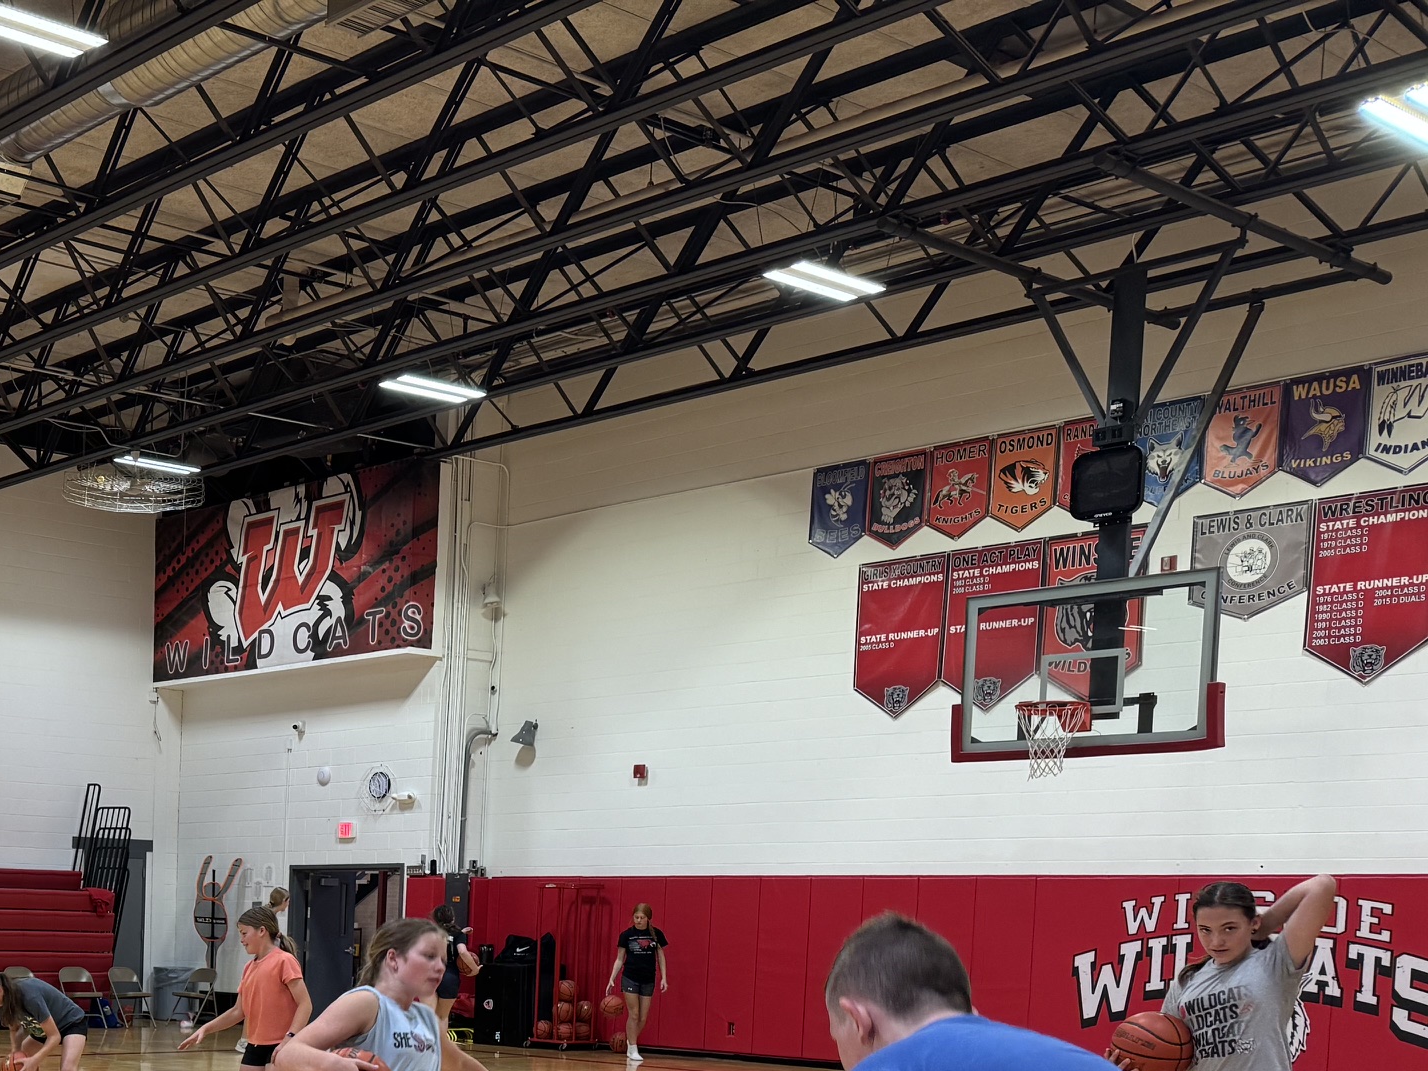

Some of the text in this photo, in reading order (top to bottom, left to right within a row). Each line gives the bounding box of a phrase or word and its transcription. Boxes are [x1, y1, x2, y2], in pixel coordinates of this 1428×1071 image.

[1377, 361, 1428, 386] WINNEB
[1292, 373, 1362, 401] WAUSA
[1155, 400, 1201, 419] COUNTY
[998, 432, 1053, 455] OSMOND
[1374, 438, 1428, 455] INDIAN
[935, 443, 988, 466] HOMER
[1290, 451, 1352, 469] VIKINGS
[875, 454, 925, 477] CREIGHTON
[1212, 462, 1270, 479] BLUJAYS
[816, 465, 866, 487] BLOOMFIELD
[996, 497, 1047, 515] TIGERS
[872, 516, 921, 534] BULLDOGS
[934, 508, 982, 525] KNIGHTS
[1200, 506, 1305, 536] LEWIS & CLARK
[1319, 509, 1428, 532] STATE CHAMPION
[814, 523, 862, 544] BEES
[1242, 533, 1256, 541] AND
[1257, 534, 1275, 549] CLARK
[1337, 529, 1362, 538] CLASS
[1363, 527, 1369, 535] C
[1336, 545, 1360, 555] CLASS
[1337, 537, 1361, 547] CLASS
[953, 545, 1040, 569] ONE ACT PLAY
[863, 558, 944, 582] GIRLS X-COUNTRY
[952, 560, 1039, 580] STATE CHAMPIONS
[862, 573, 944, 592] STATE CHAMPIONS
[965, 577, 984, 586] CLASS
[965, 585, 984, 593] CLASS
[1227, 573, 1268, 589] CONFERENCE
[1316, 574, 1428, 595] STATE RUNNER-UP
[1200, 580, 1296, 605] CNFERENCE
[1333, 592, 1358, 602] CLASS
[1393, 586, 1418, 595] CLASS
[1399, 594, 1426, 603] DUALS
[1332, 601, 1357, 610] CLASS
[1358, 600, 1364, 608] D
[1331, 618, 1355, 628] CLASS
[1332, 610, 1356, 619] CLASS
[949, 617, 1035, 634] STA RUNNER-UP
[1331, 627, 1355, 636] CLASS
[1357, 626, 1362, 634] D
[165, 602, 423, 674] WILDCATS
[860, 627, 939, 644] STATE RUNNER-UP
[1330, 636, 1354, 645] CLASS
[872, 642, 889, 650] CLASS
[1121, 890, 1395, 943] WIDE
[1072, 932, 1428, 1051] WILATS
[393, 1031, 412, 1049] SHE
